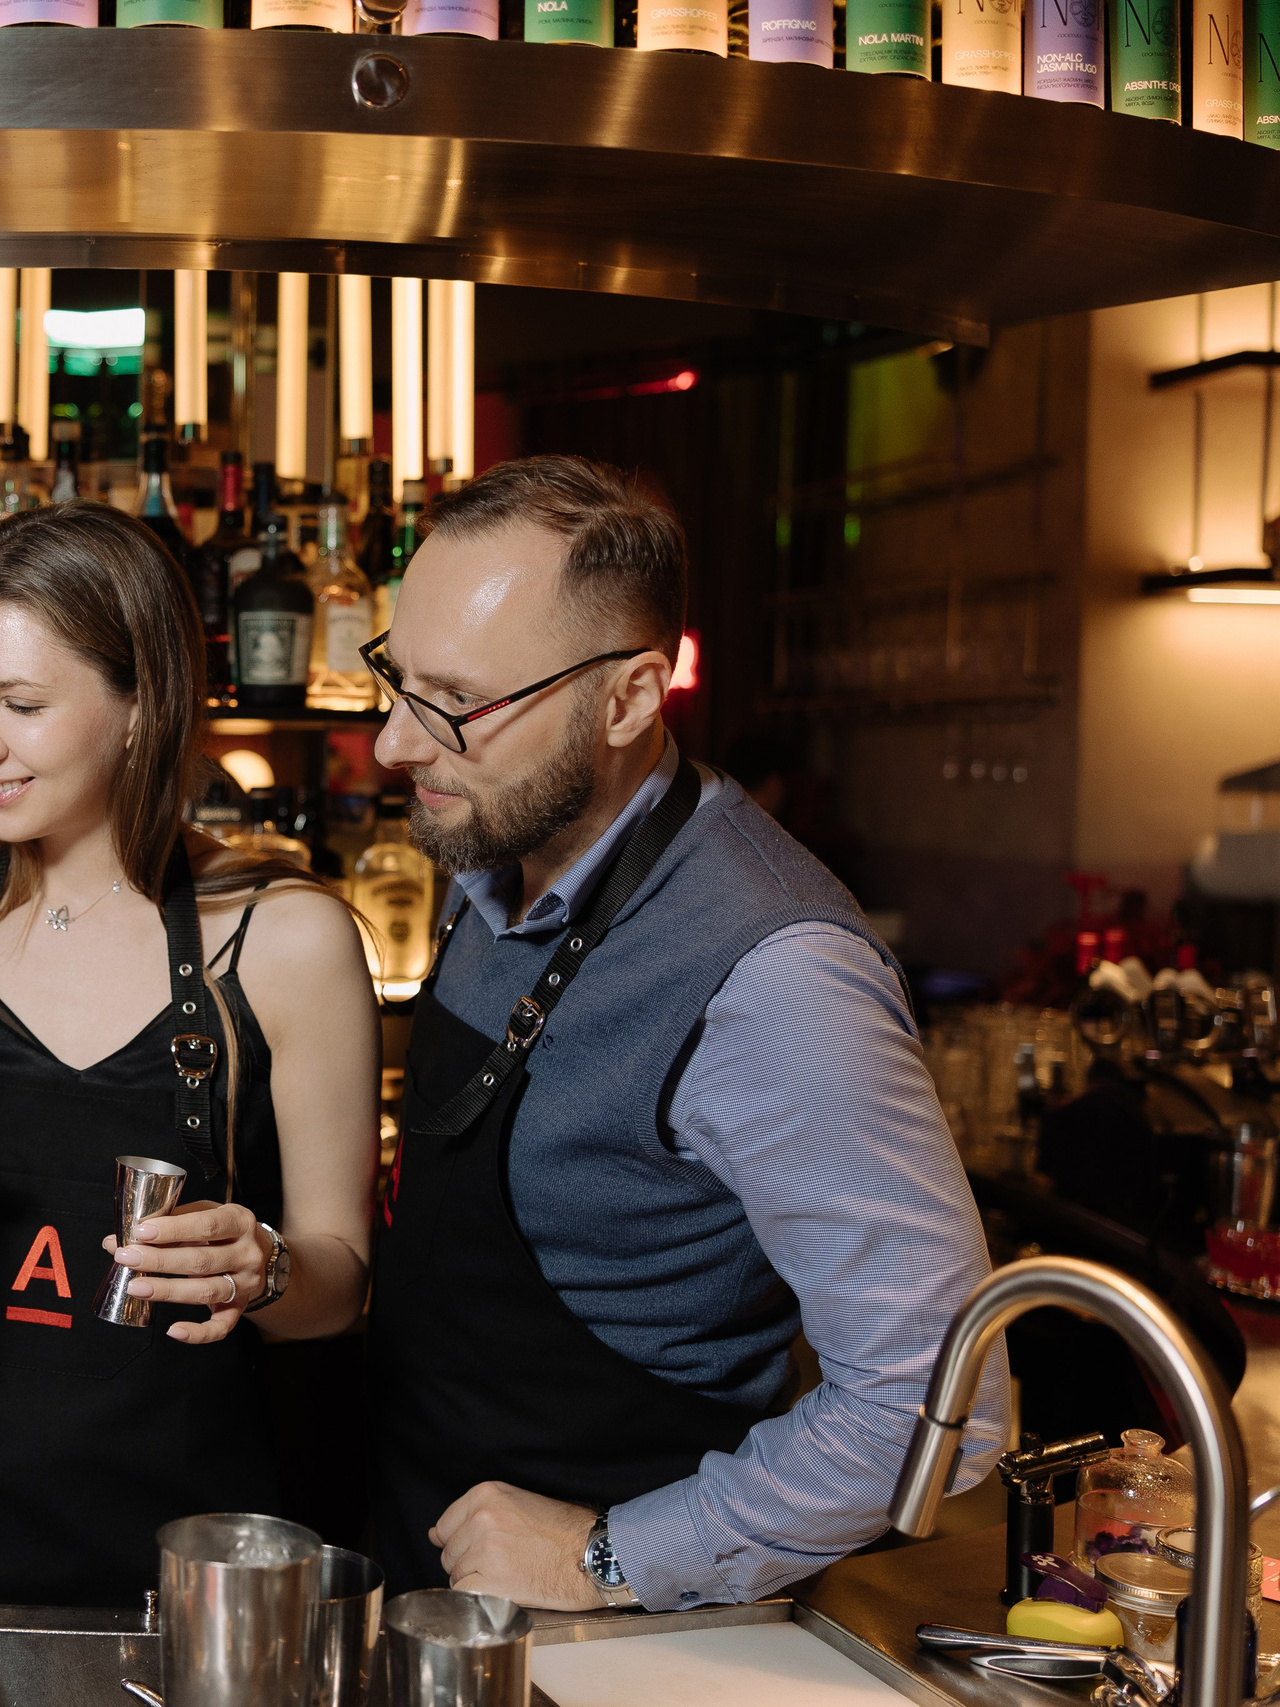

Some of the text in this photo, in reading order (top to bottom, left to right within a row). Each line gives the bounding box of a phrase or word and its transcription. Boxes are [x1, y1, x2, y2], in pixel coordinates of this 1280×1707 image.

[537, 1, 568, 13] NOLA
[650, 7, 718, 21] GRASSHOPPER
[761, 19, 817, 32] ROFFIGNAC
[858, 33, 889, 46] NOLA
[1037, 53, 1083, 64] NON-ALC
[1036, 62, 1098, 75] JASMIN HUGO
[1124, 80, 1168, 92] ABSINTHE
